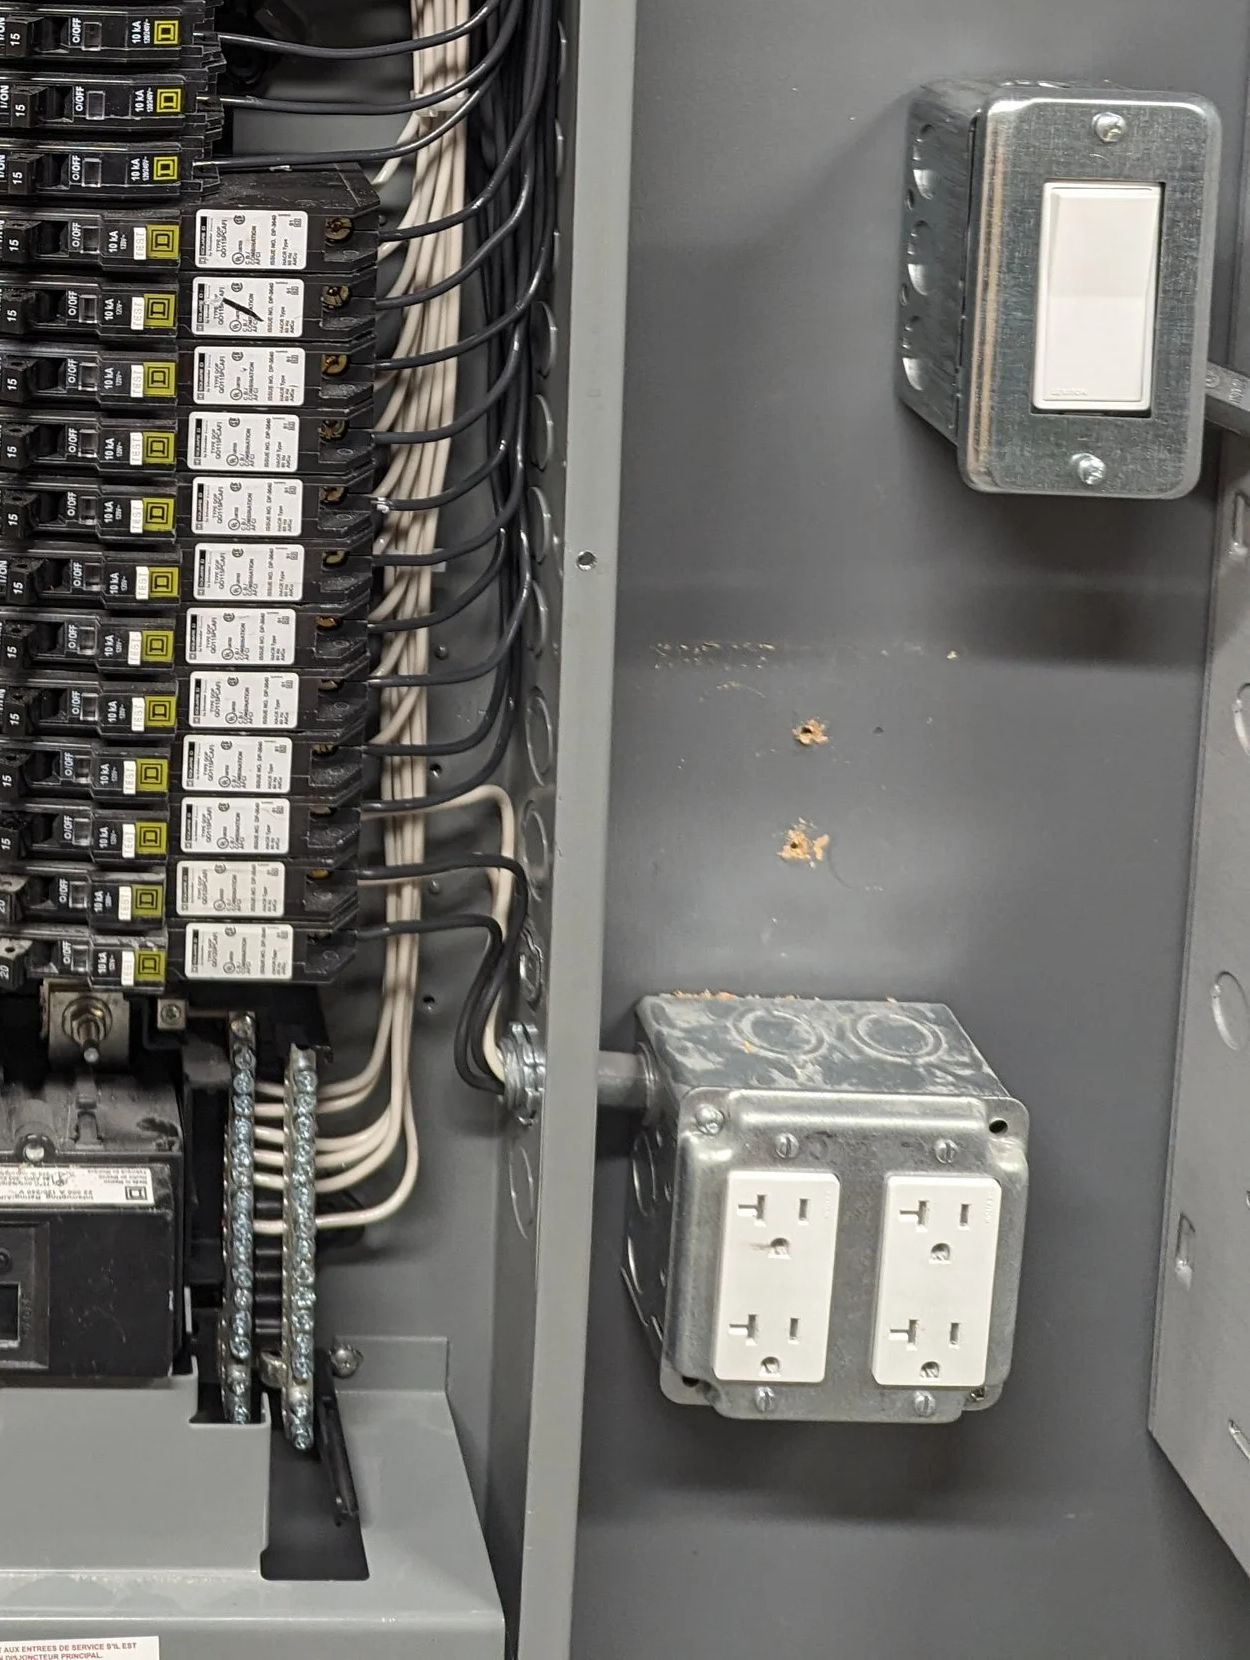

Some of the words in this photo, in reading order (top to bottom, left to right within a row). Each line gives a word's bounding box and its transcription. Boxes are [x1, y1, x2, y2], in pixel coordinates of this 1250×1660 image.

[10, 33, 20, 46] 15
[0, 85, 9, 108] I/ON
[15, 104, 25, 117] 15
[13, 172, 22, 184] 15
[9, 239, 19, 251] 15
[7, 309, 16, 322] 15
[7, 379, 17, 391] 15
[7, 446, 17, 458] 15
[9, 513, 18, 526] 15
[13, 582, 23, 595] 15
[7, 646, 17, 659] 15
[10, 714, 19, 726] 15
[3, 775, 12, 787] 15
[1, 838, 10, 850] 15
[0, 965, 10, 979] 20
